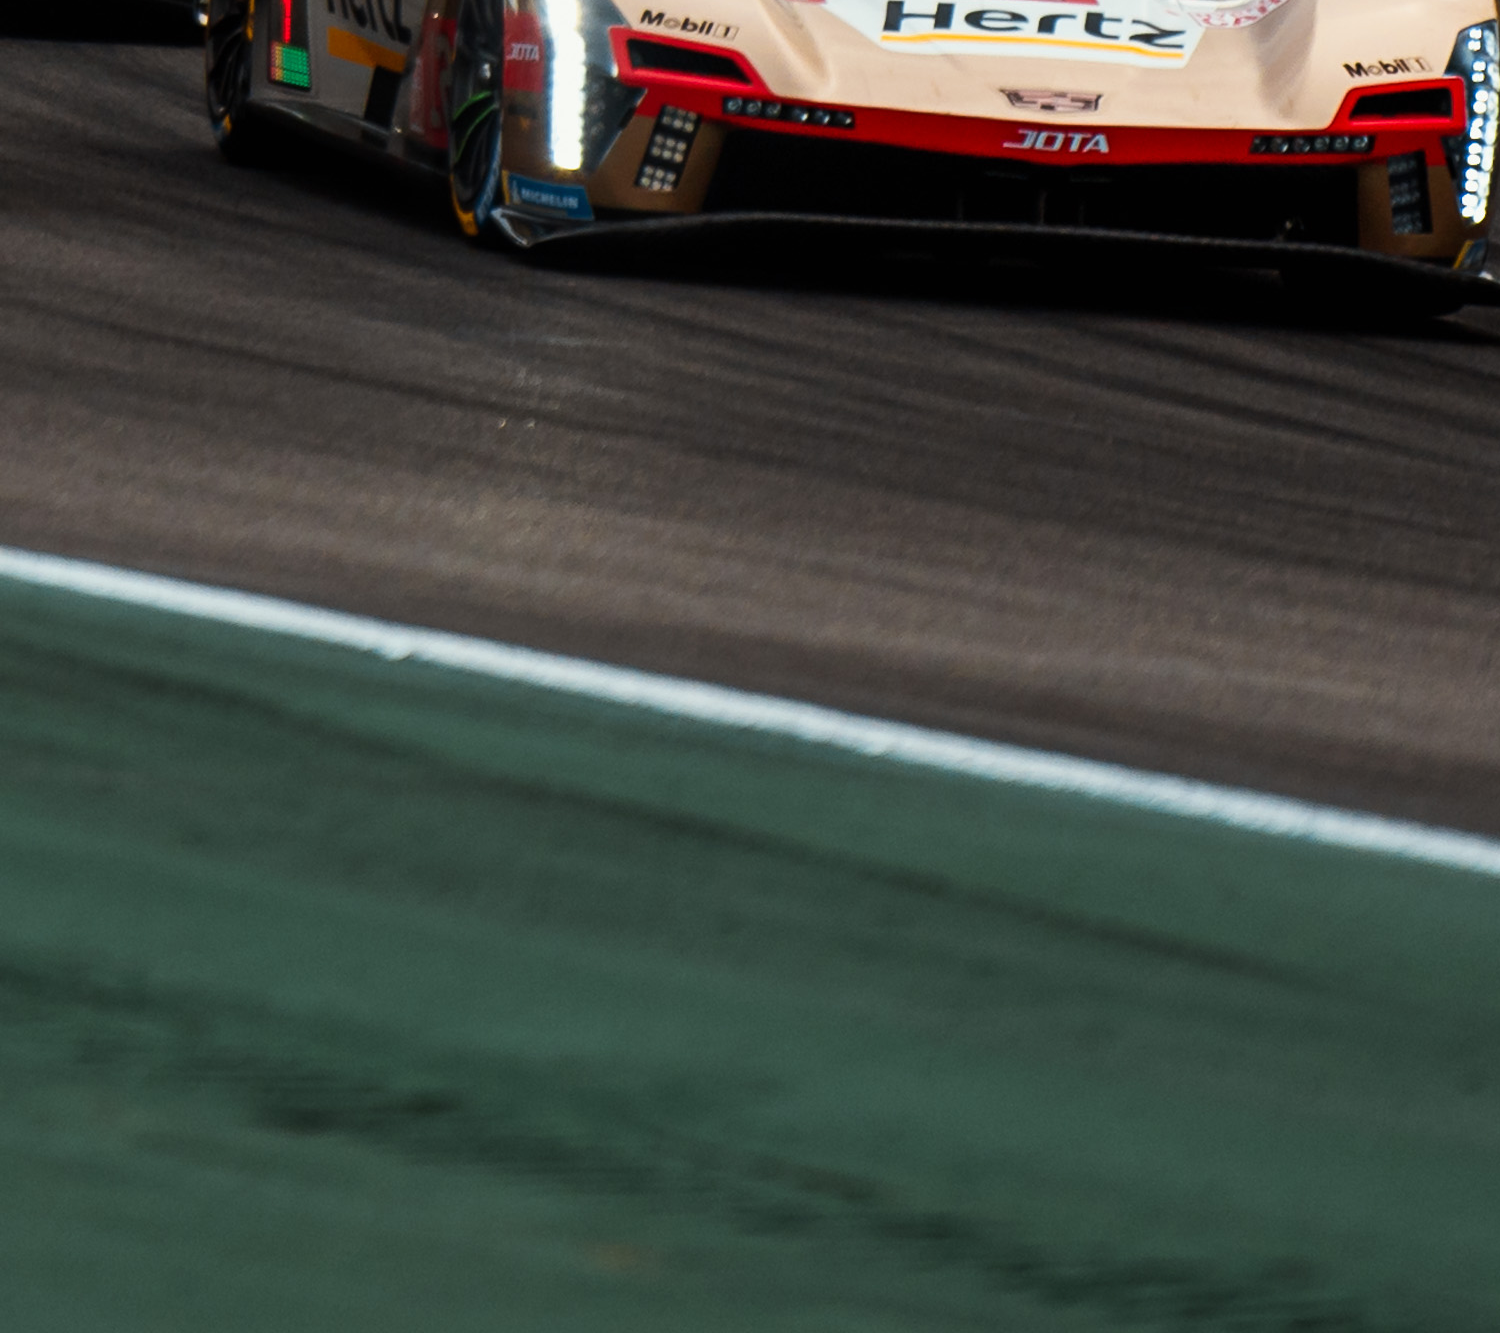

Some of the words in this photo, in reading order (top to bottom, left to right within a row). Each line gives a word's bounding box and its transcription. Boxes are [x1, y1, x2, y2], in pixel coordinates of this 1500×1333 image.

[639, 8, 714, 38] Mobil
[883, 0, 1186, 50] Hertz
[1342, 57, 1409, 79] Mobil
[1002, 129, 1111, 155] JOTA
[520, 186, 580, 210] MICHELIN
